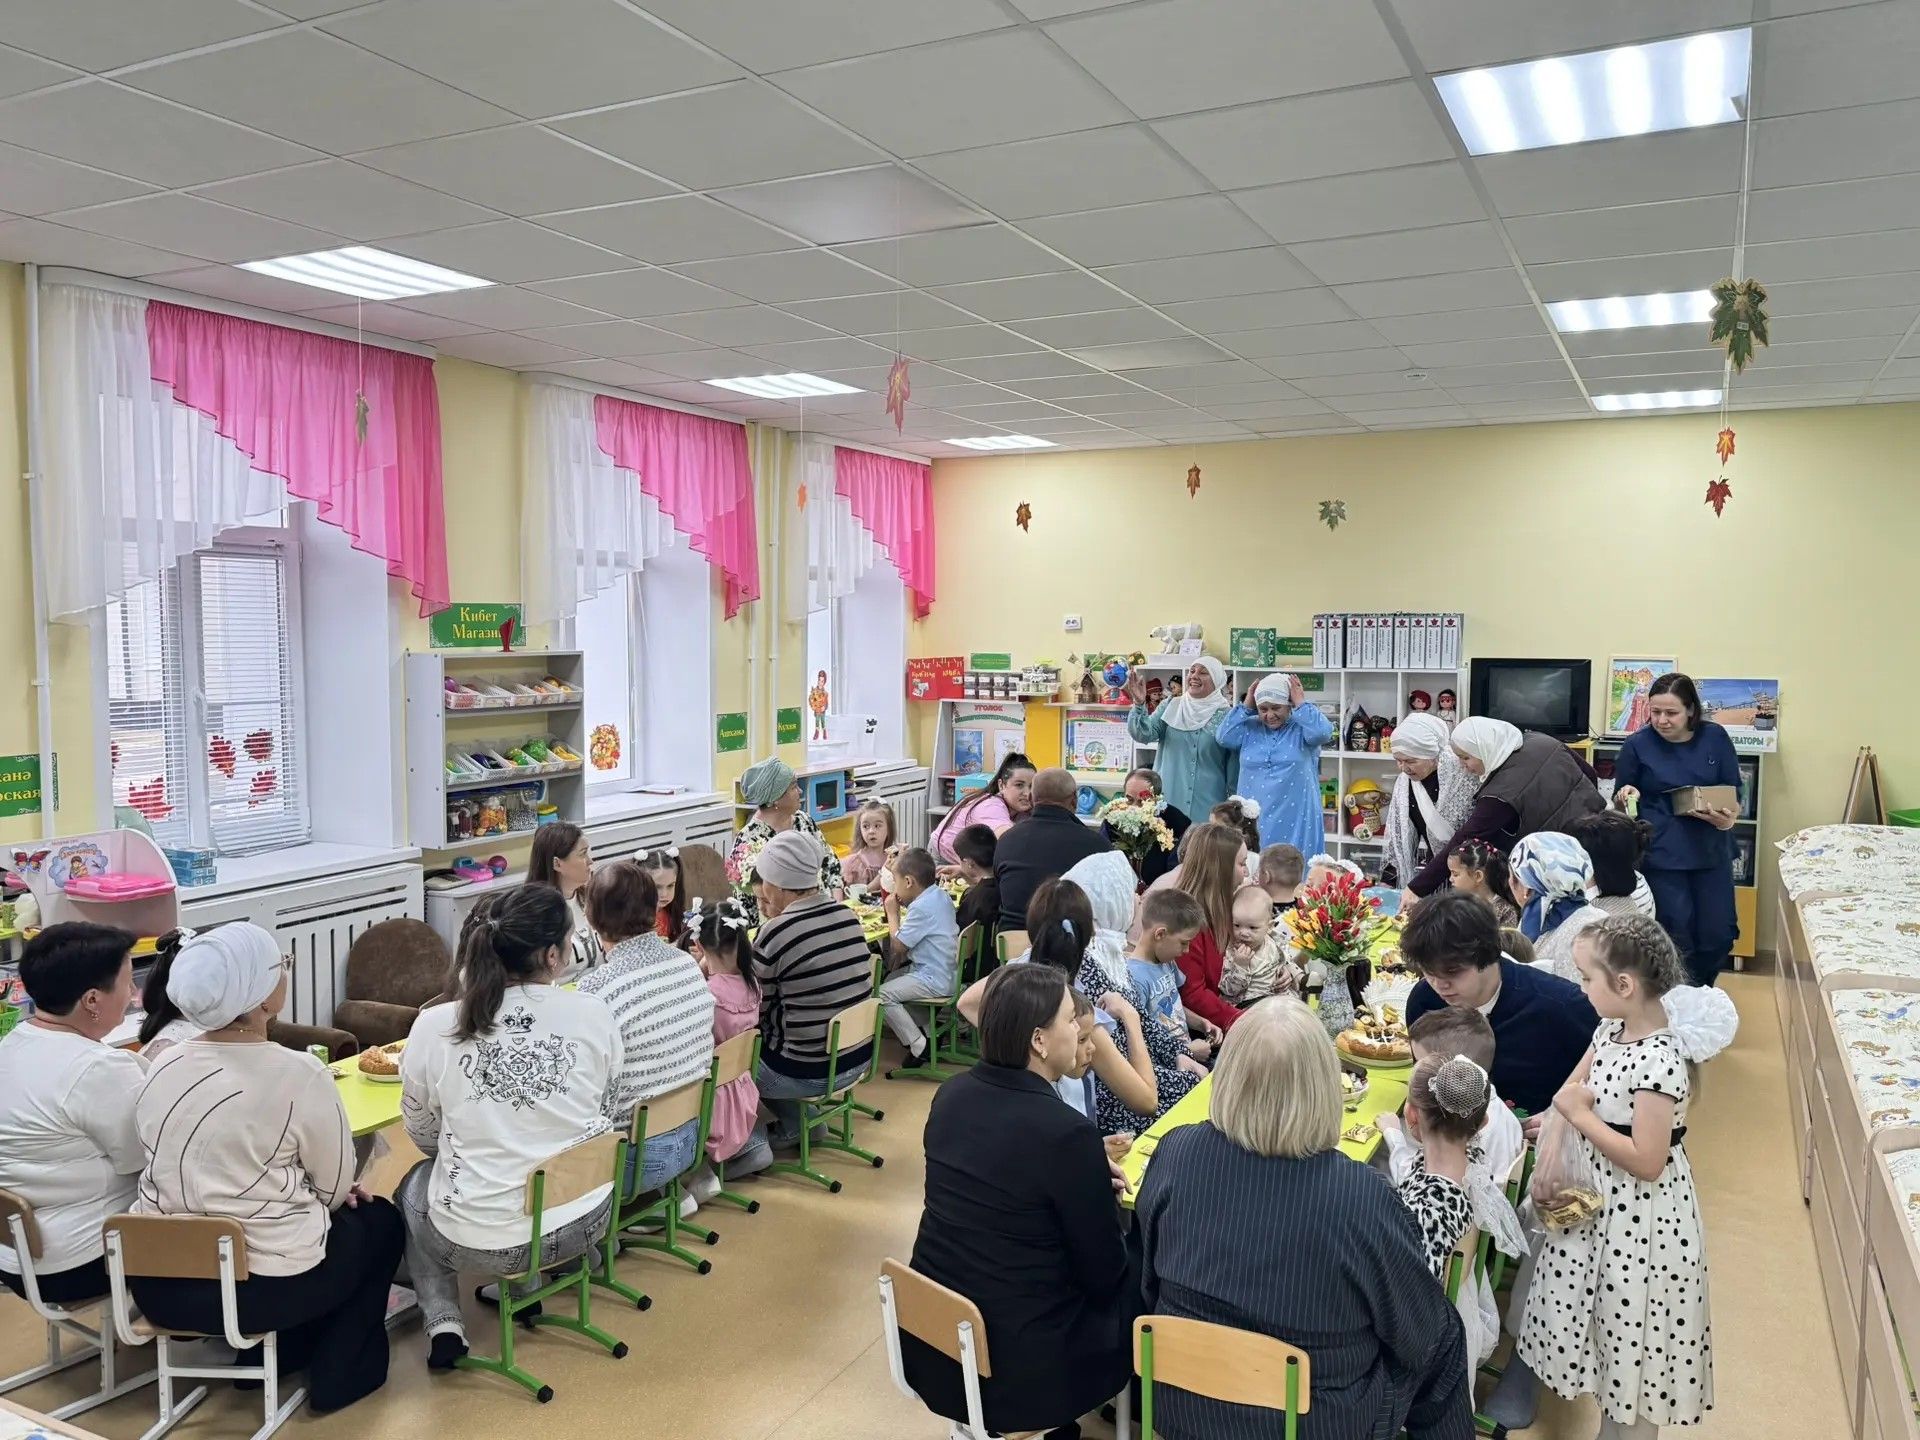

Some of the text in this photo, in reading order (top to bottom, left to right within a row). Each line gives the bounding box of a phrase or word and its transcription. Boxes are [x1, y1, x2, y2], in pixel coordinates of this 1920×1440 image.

[460, 606, 498, 622] Кибет
[452, 623, 502, 639] Магази
[974, 704, 1004, 712] УГОЛОК
[1731, 736, 1764, 746] ЕВАТОРЫ
[0, 771, 32, 783] анә
